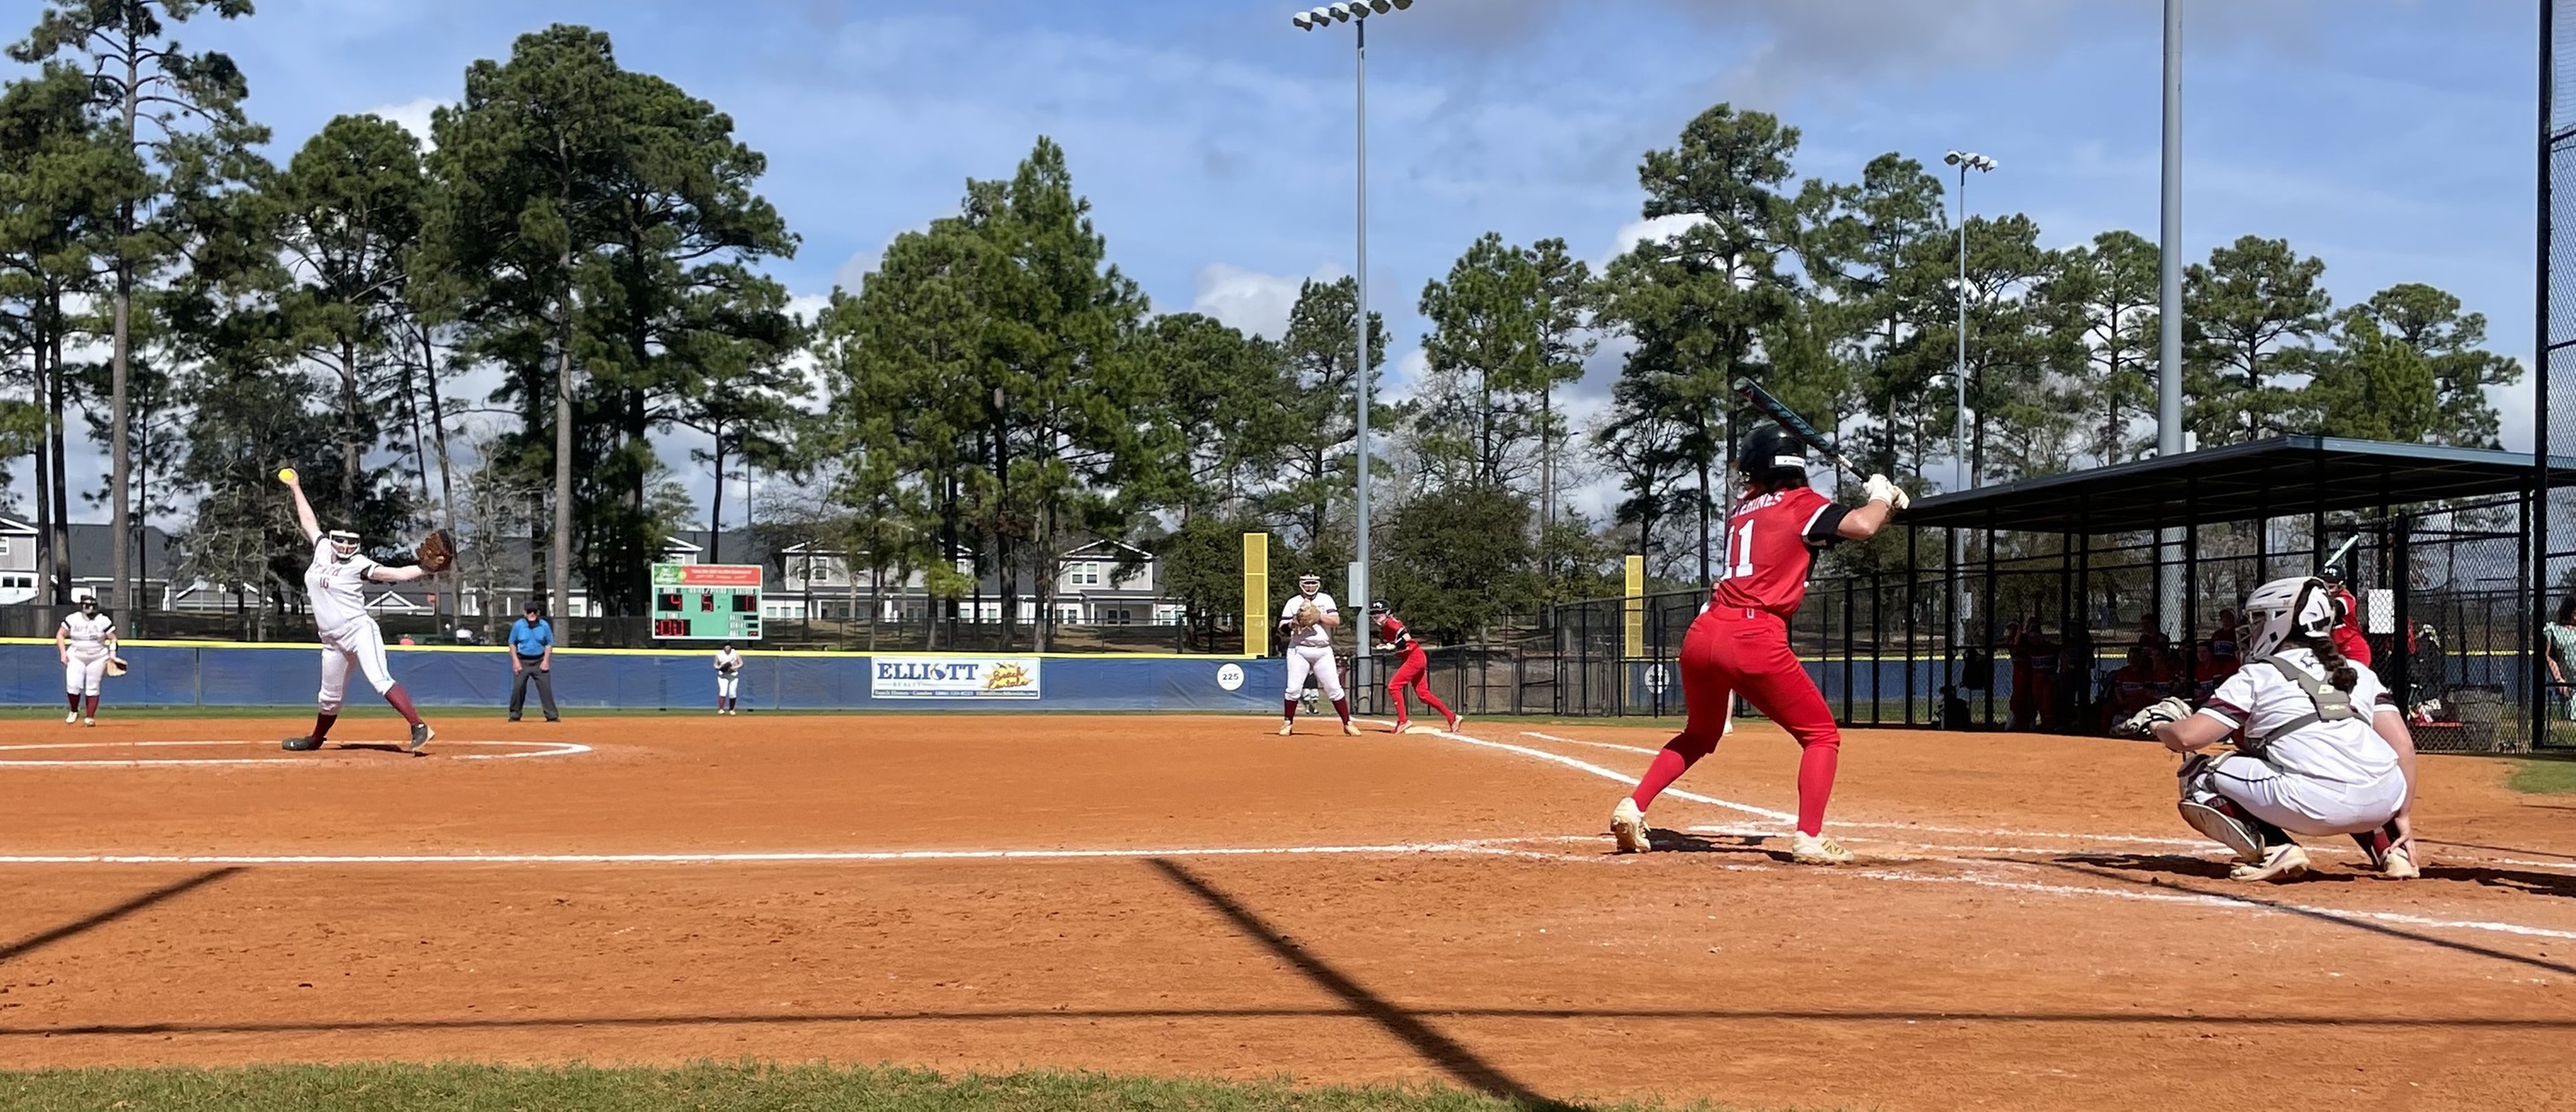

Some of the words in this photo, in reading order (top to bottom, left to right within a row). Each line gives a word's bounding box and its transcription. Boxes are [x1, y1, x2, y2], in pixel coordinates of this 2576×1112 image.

[1720, 519, 1754, 581] 11
[702, 593, 713, 613] 5
[877, 662, 979, 681] ELLIOTT
[993, 666, 1027, 681] Beach
